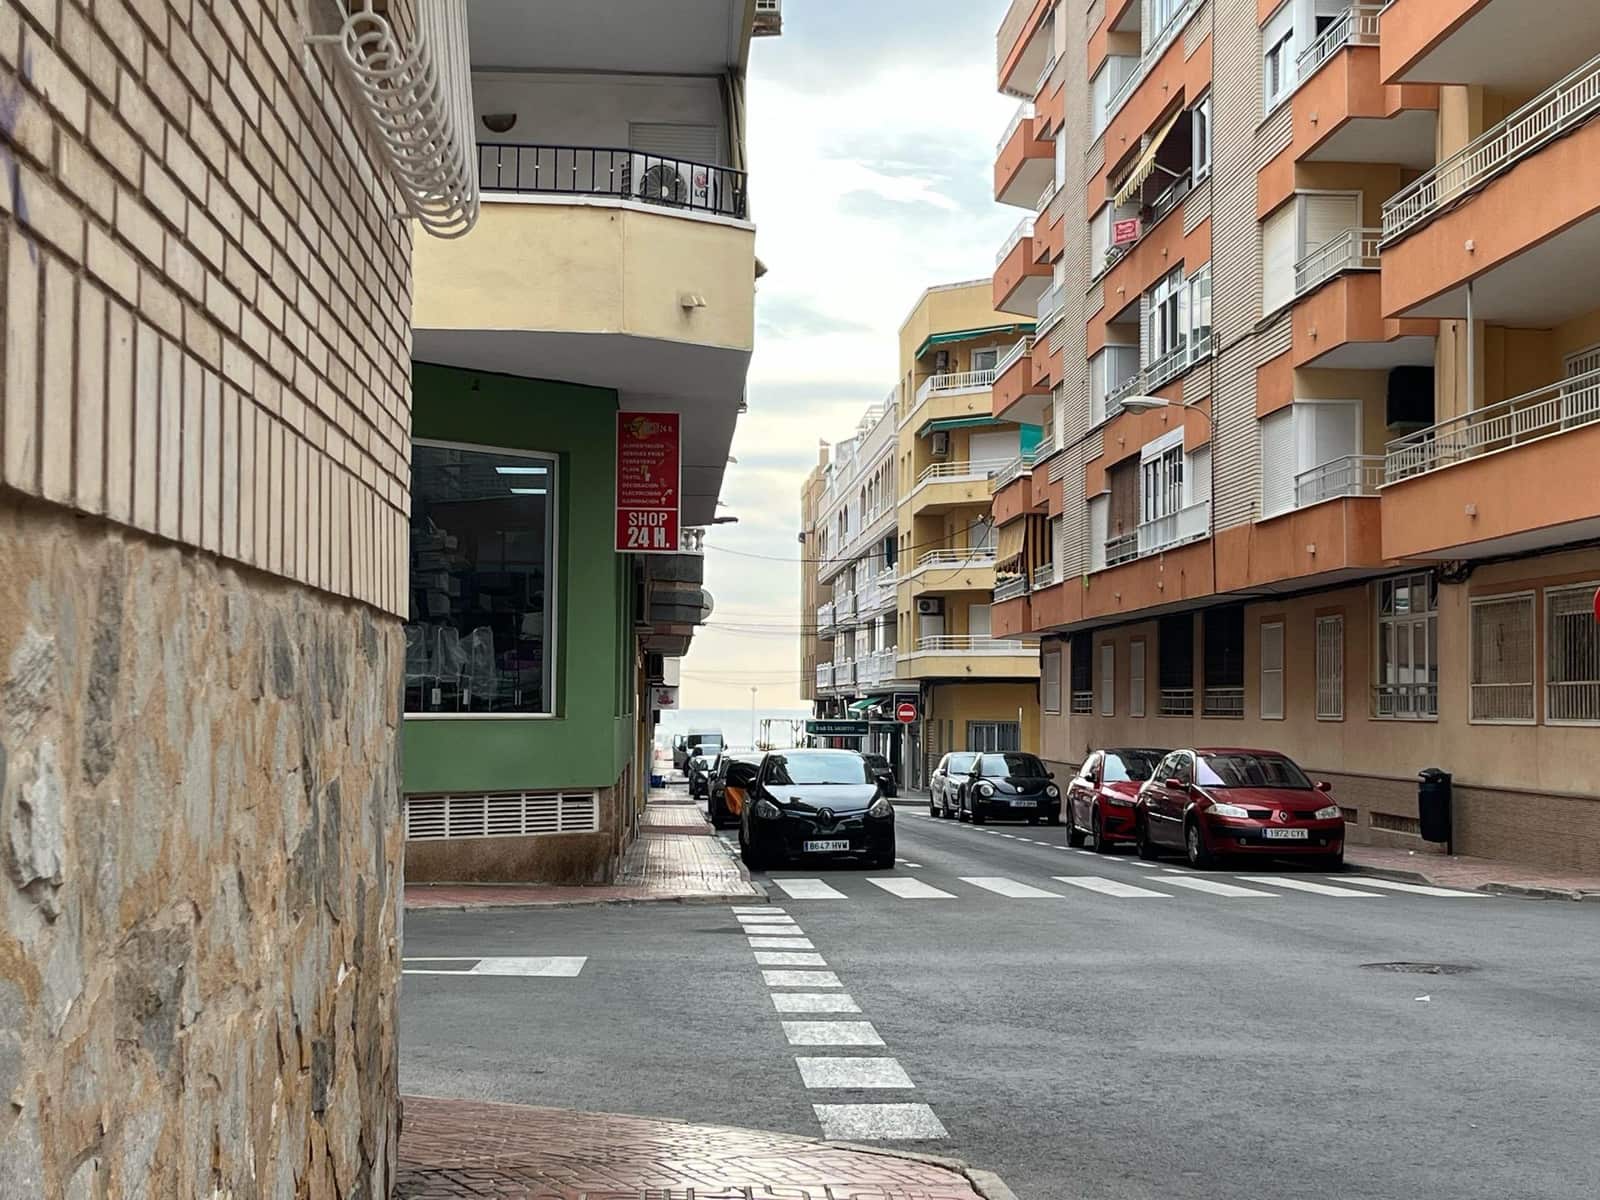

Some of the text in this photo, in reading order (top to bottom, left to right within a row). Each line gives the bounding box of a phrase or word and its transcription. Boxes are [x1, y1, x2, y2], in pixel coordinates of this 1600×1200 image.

[628, 512, 668, 526] SHOP
[627, 527, 671, 548] 24 H.
